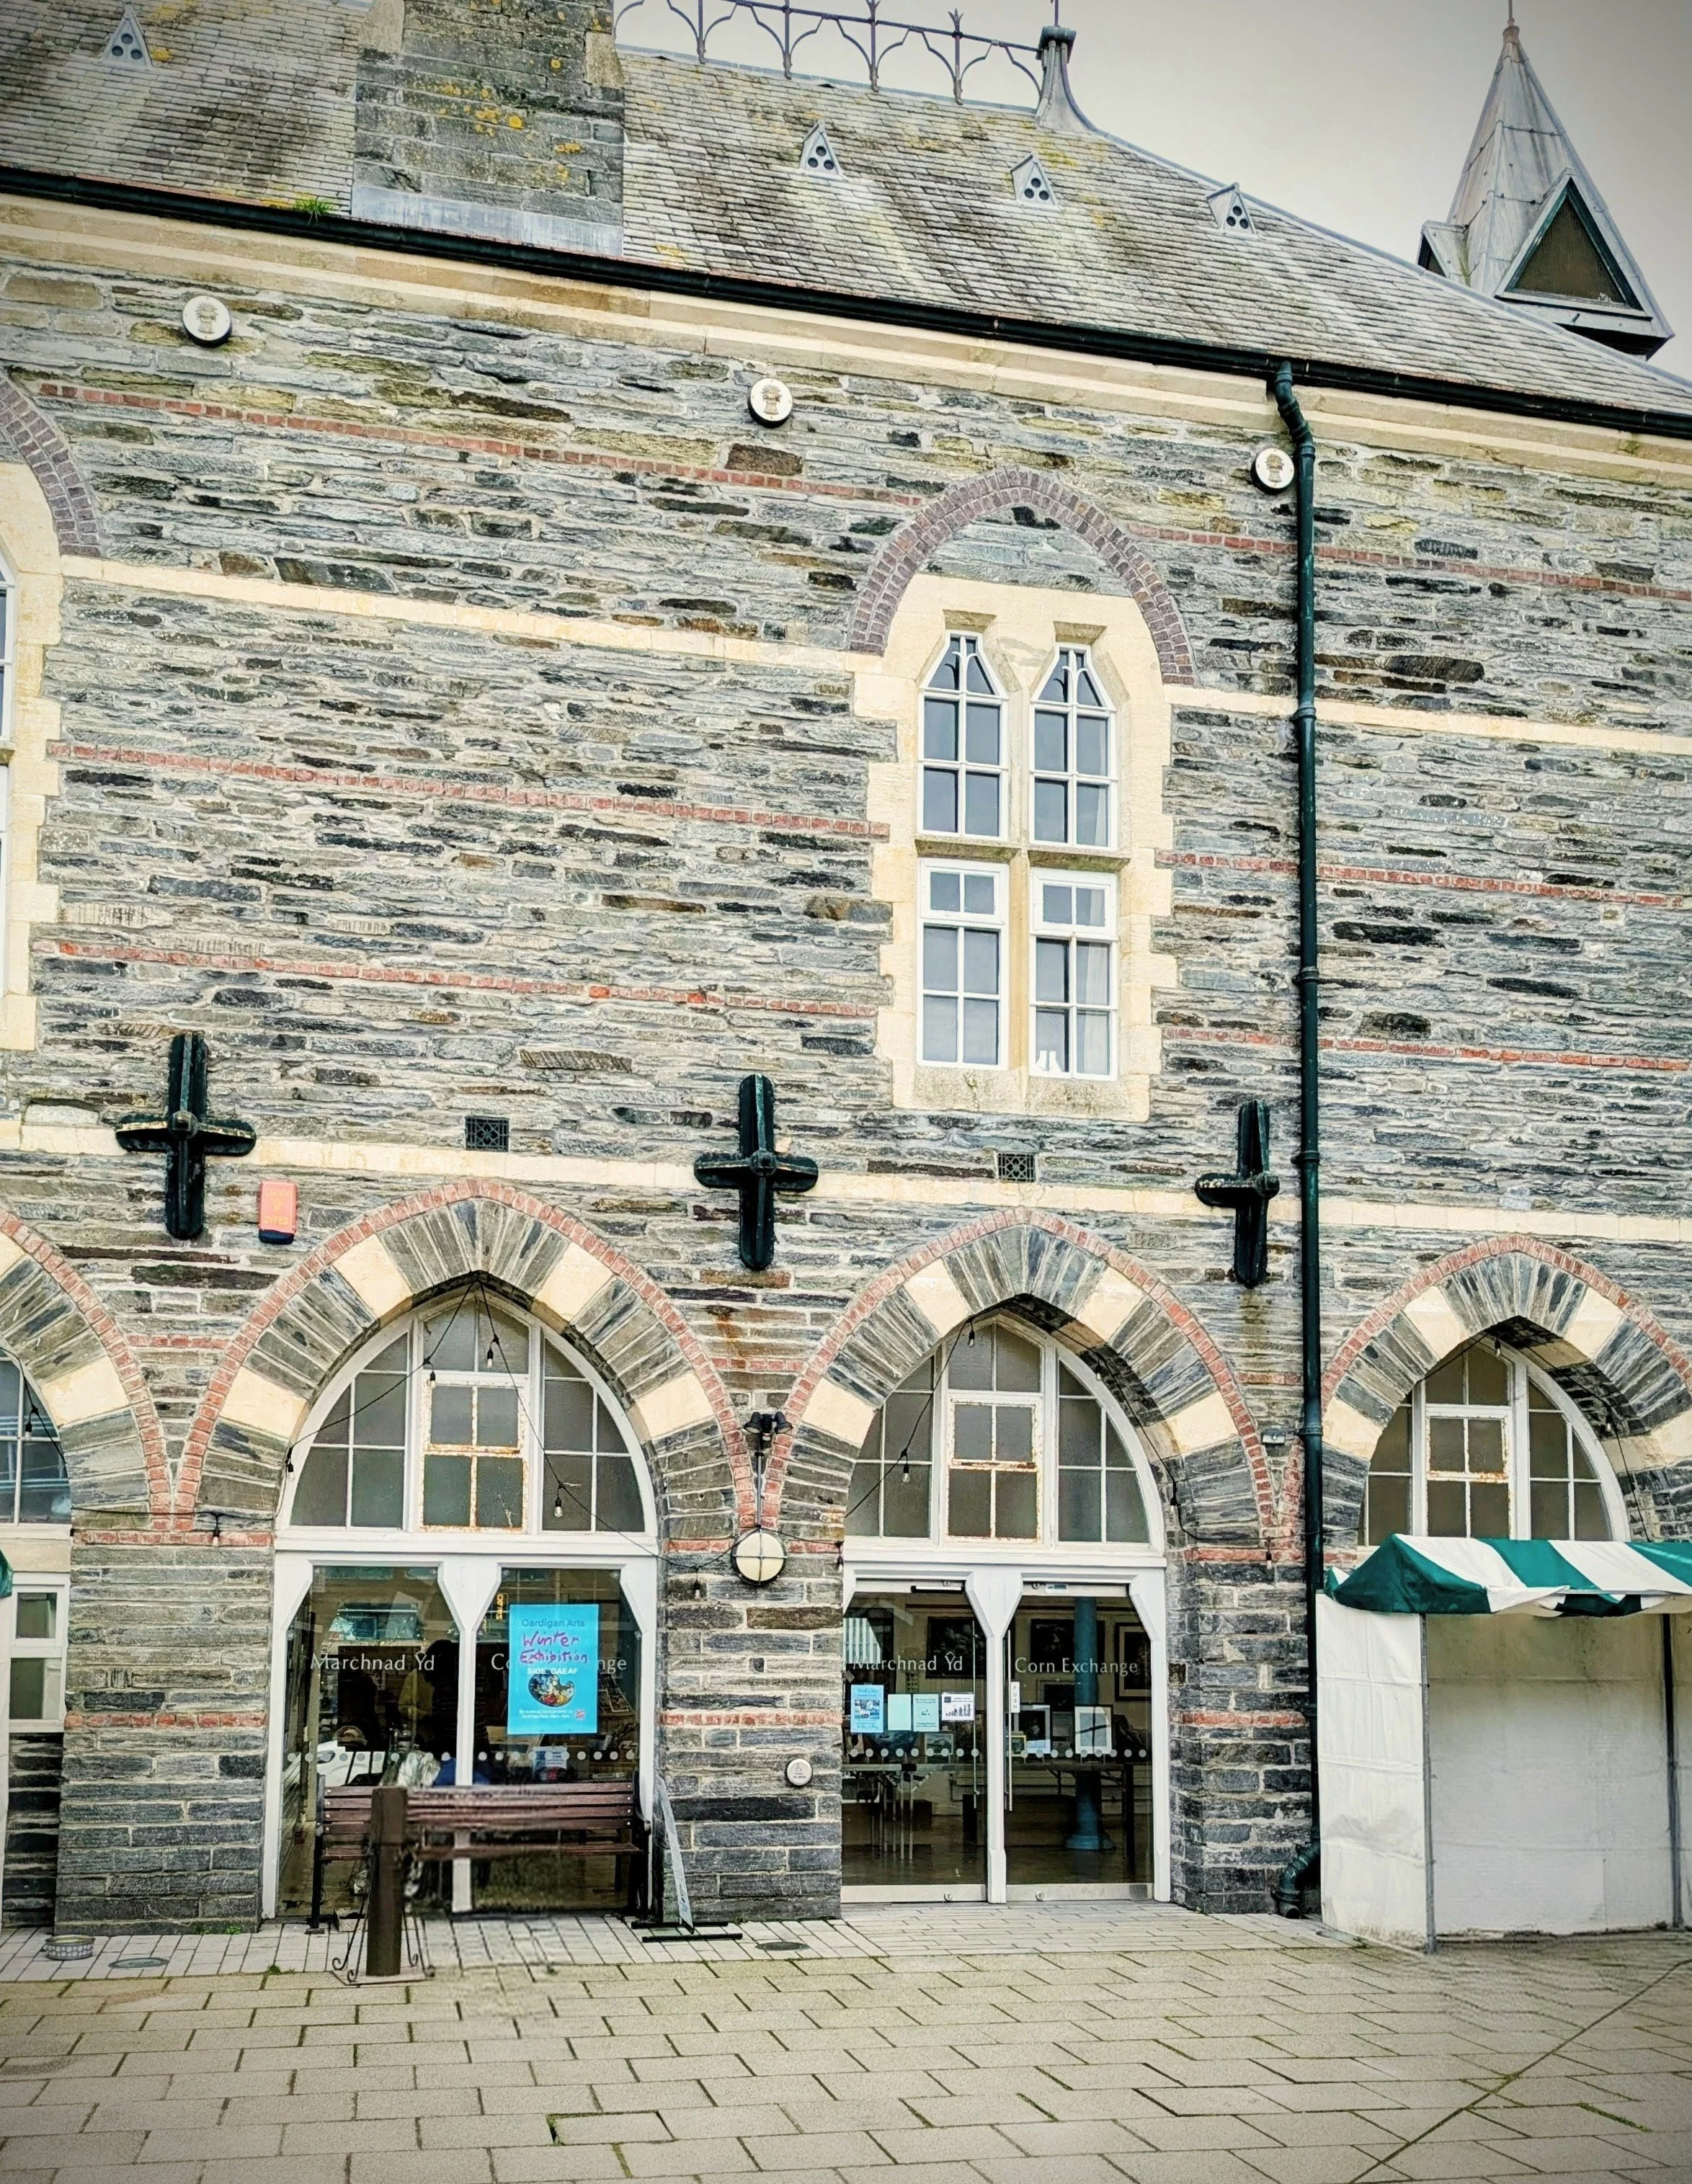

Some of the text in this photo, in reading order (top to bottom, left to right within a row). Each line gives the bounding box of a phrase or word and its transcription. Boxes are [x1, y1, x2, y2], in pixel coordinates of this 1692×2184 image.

[264, 1215, 289, 1225] DYFED
[522, 1618, 565, 1628] Cardigan
[522, 1631, 579, 1646] Winter
[310, 1653, 405, 1670] Marchnad
[520, 1649, 588, 1664] Exhibition
[852, 1655, 938, 1670] Marchnad
[1015, 1657, 1139, 1677] Corn Exchange
